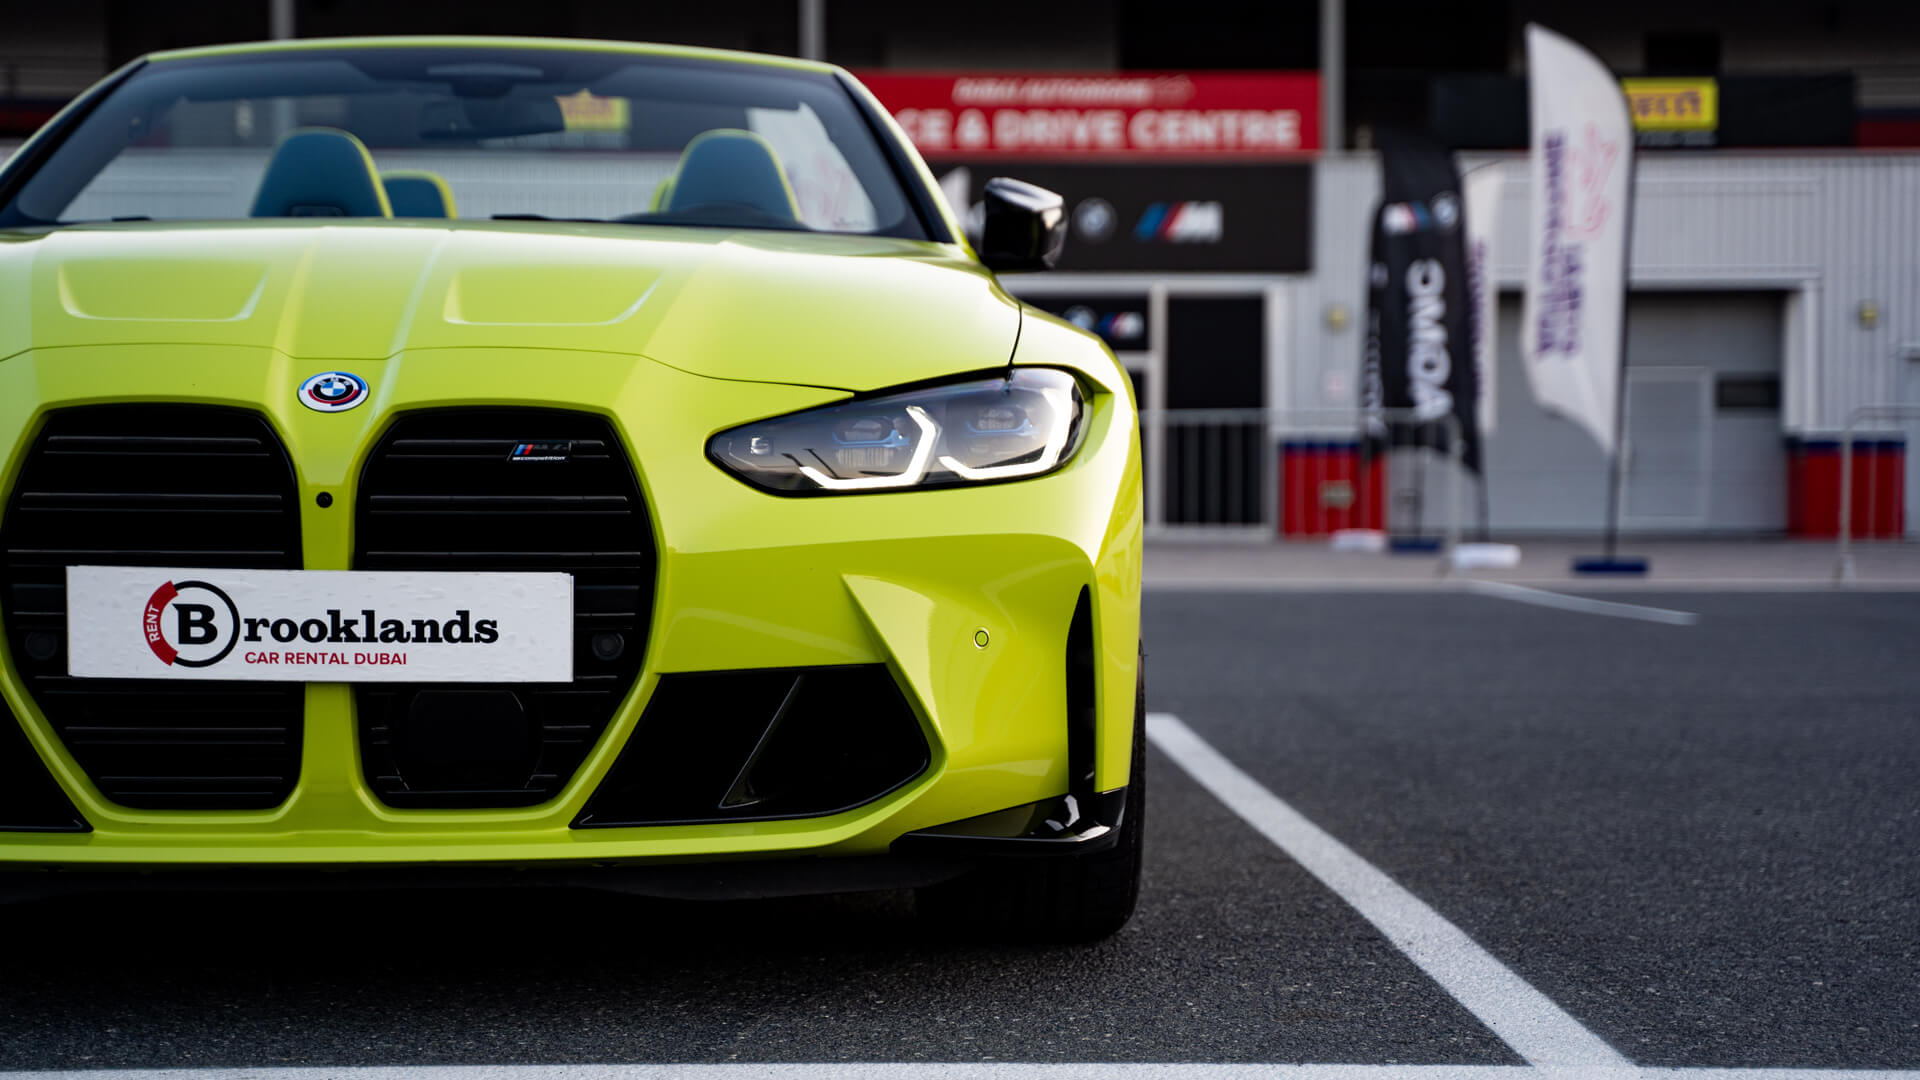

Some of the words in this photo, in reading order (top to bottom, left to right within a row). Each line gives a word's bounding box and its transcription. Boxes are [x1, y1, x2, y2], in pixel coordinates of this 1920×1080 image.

[994, 110, 1126, 148] DRIVE
[1129, 109, 1299, 148] CENTRE
[146, 604, 161, 642] RENT
[244, 652, 280, 665] CAR
[284, 652, 350, 665] RENTAL
[354, 652, 408, 666] DUBAI
